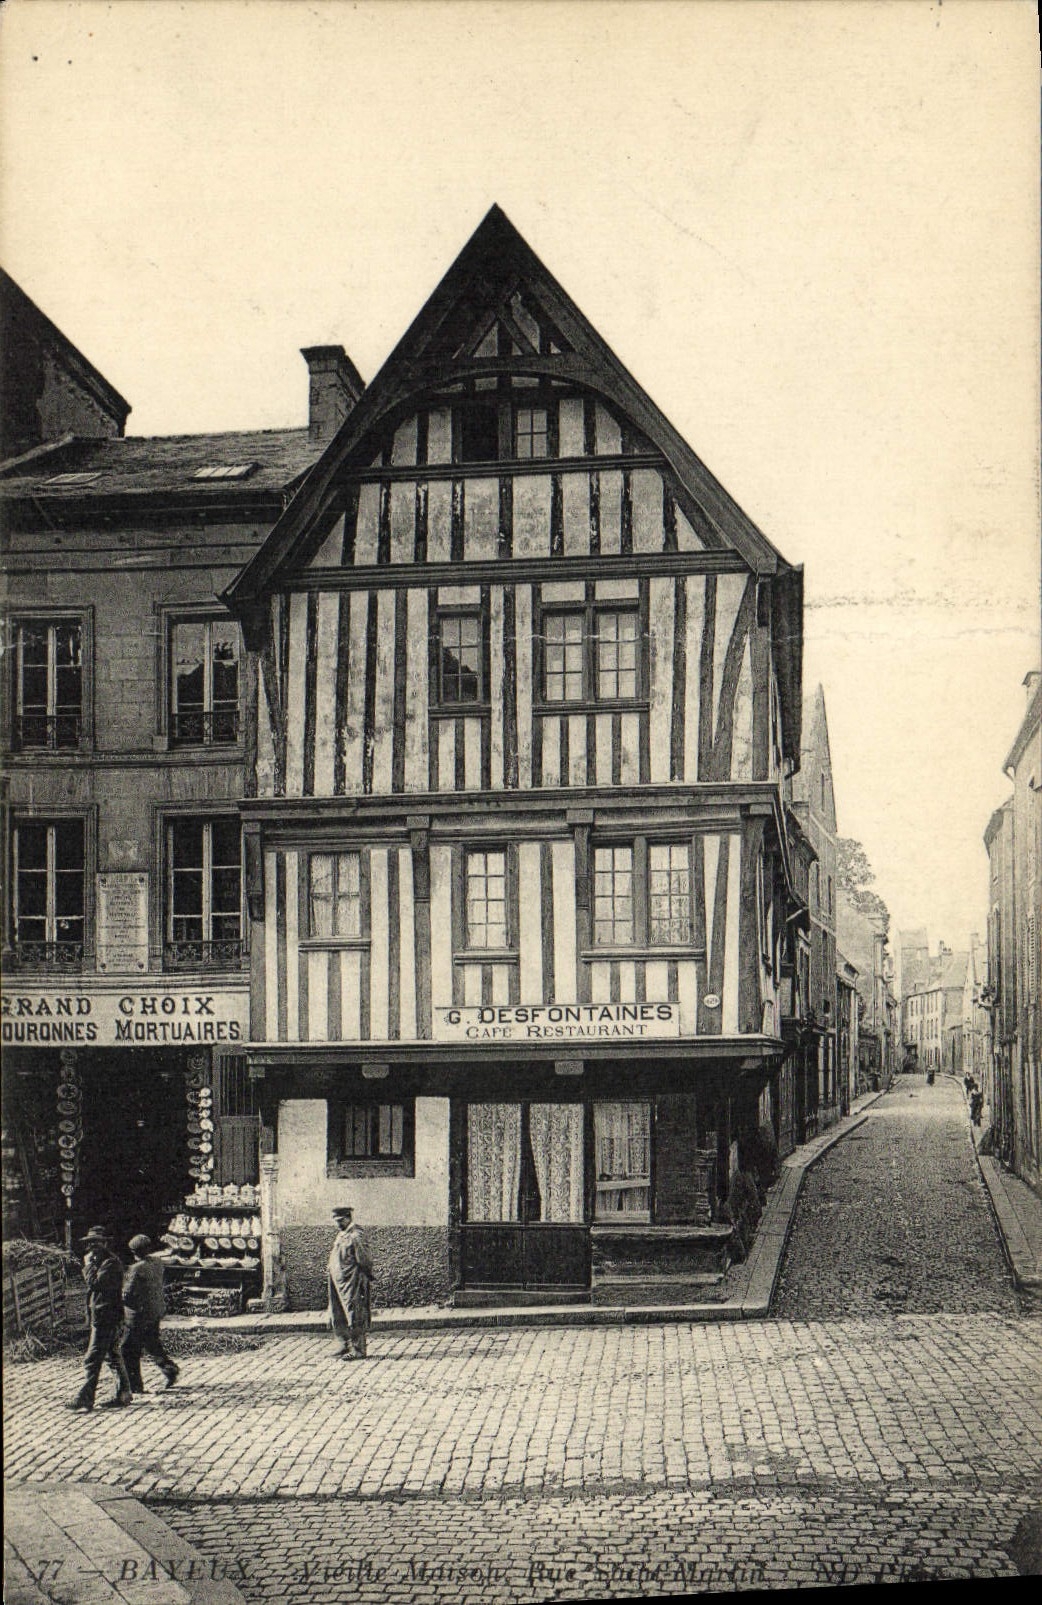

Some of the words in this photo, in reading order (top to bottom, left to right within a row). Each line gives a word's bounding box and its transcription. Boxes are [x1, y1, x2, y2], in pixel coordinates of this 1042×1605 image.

[119, 996, 215, 1016] CHOIX
[480, 1004, 673, 1024] DESFONTAINES
[2, 1022, 98, 1042] OURONNES
[115, 1019, 241, 1042] MORTUAIRES
[527, 1024, 648, 1039] RESTAURANT
